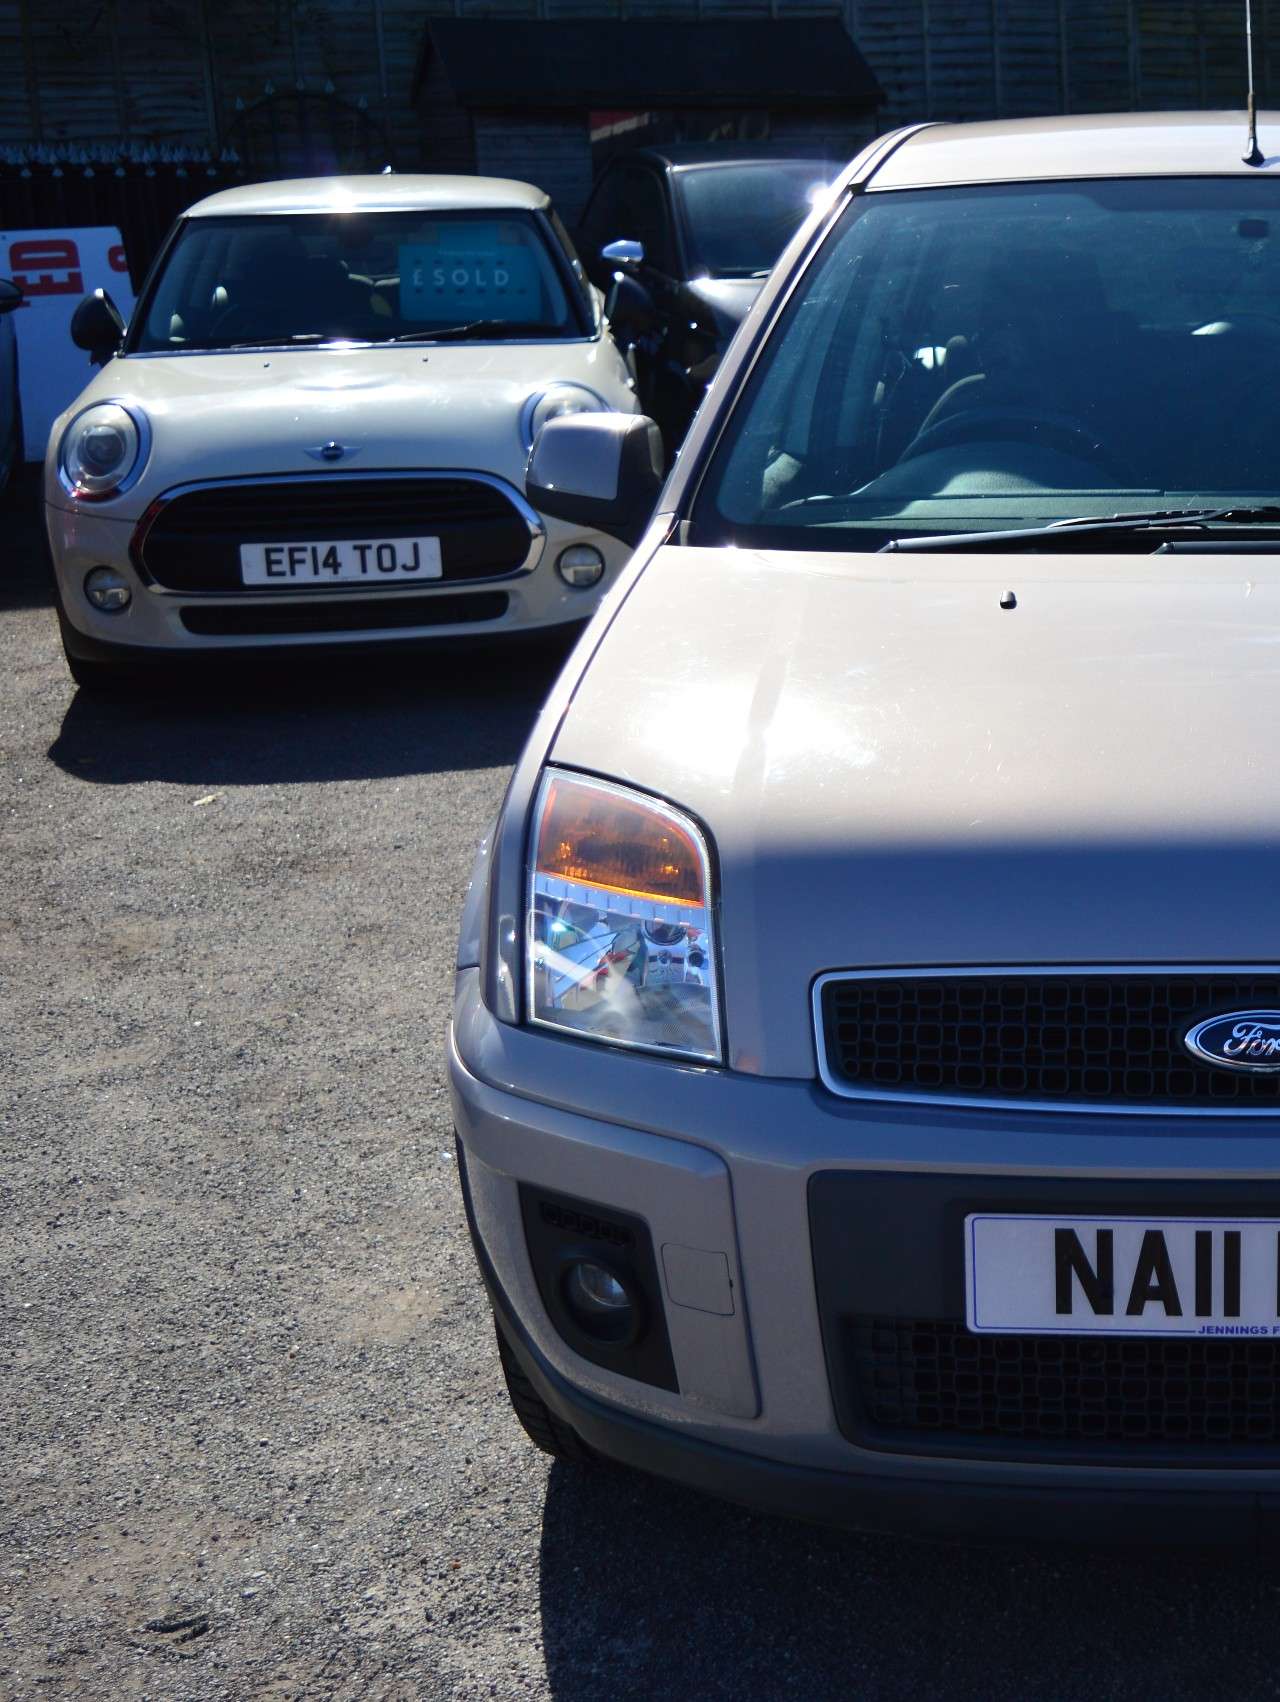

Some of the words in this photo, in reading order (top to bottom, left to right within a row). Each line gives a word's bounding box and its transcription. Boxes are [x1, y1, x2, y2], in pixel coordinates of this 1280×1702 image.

[264, 545, 342, 577] EF14
[352, 542, 421, 574] TOJ
[1053, 1228, 1242, 1317] NA11
[1198, 1325, 1268, 1335] JENNINGS
